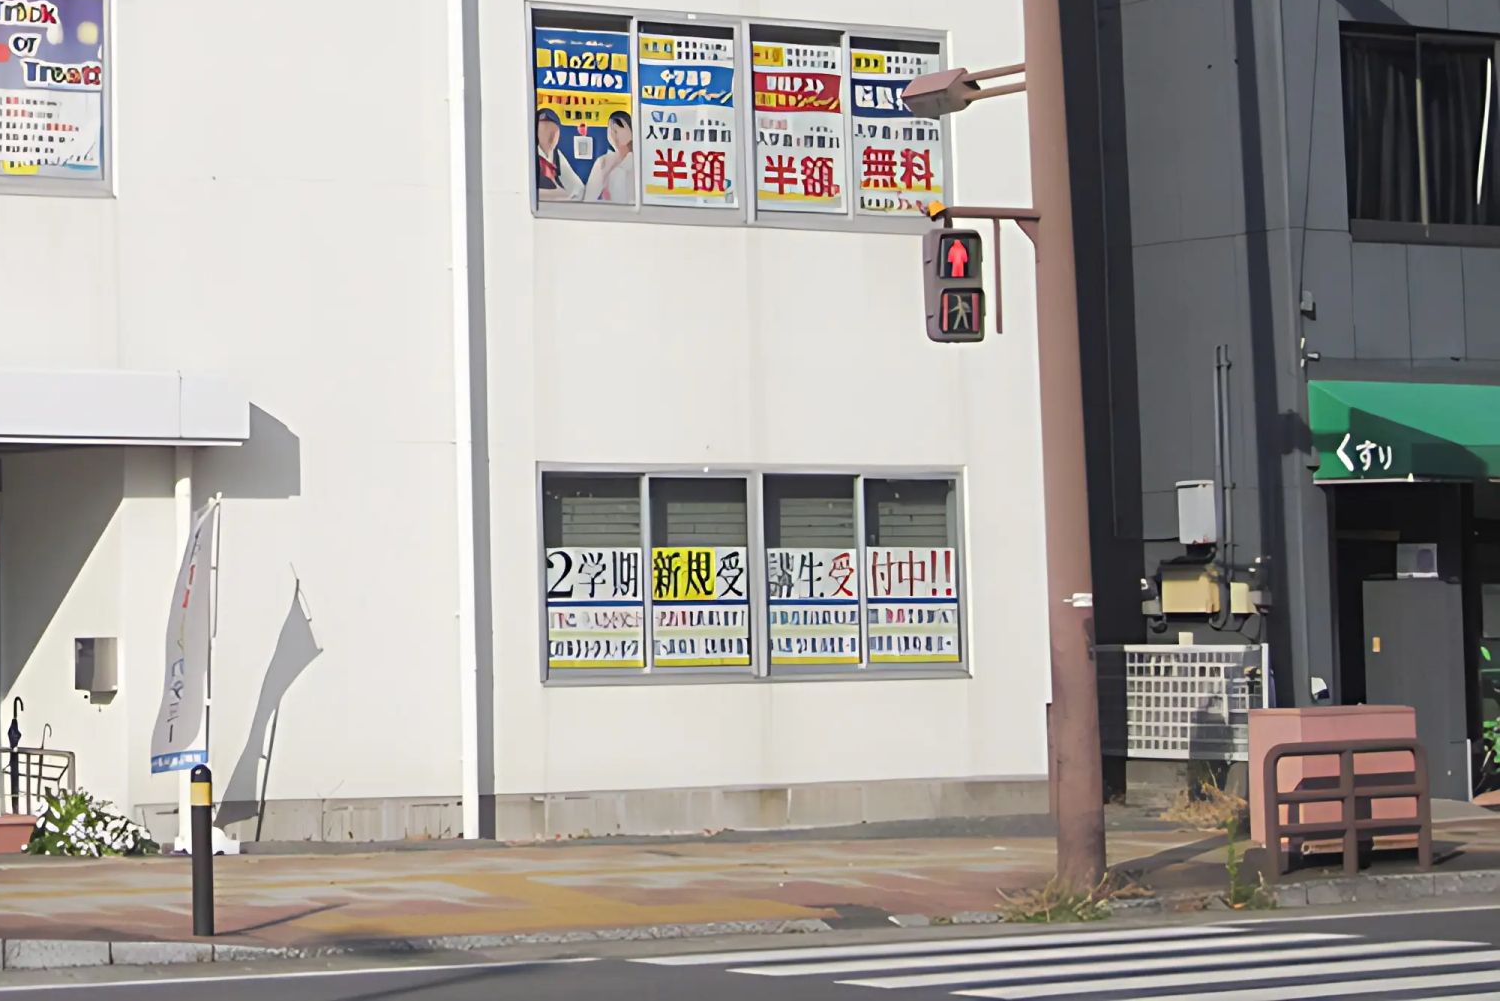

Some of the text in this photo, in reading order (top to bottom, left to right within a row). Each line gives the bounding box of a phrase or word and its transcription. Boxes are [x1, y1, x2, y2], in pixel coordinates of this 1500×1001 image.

[12, 35, 38, 53] or
[653, 147, 727, 193] 半額
[763, 154, 836, 198] 半額
[859, 145, 936, 191] 無料
[1336, 432, 1393, 473] くすり
